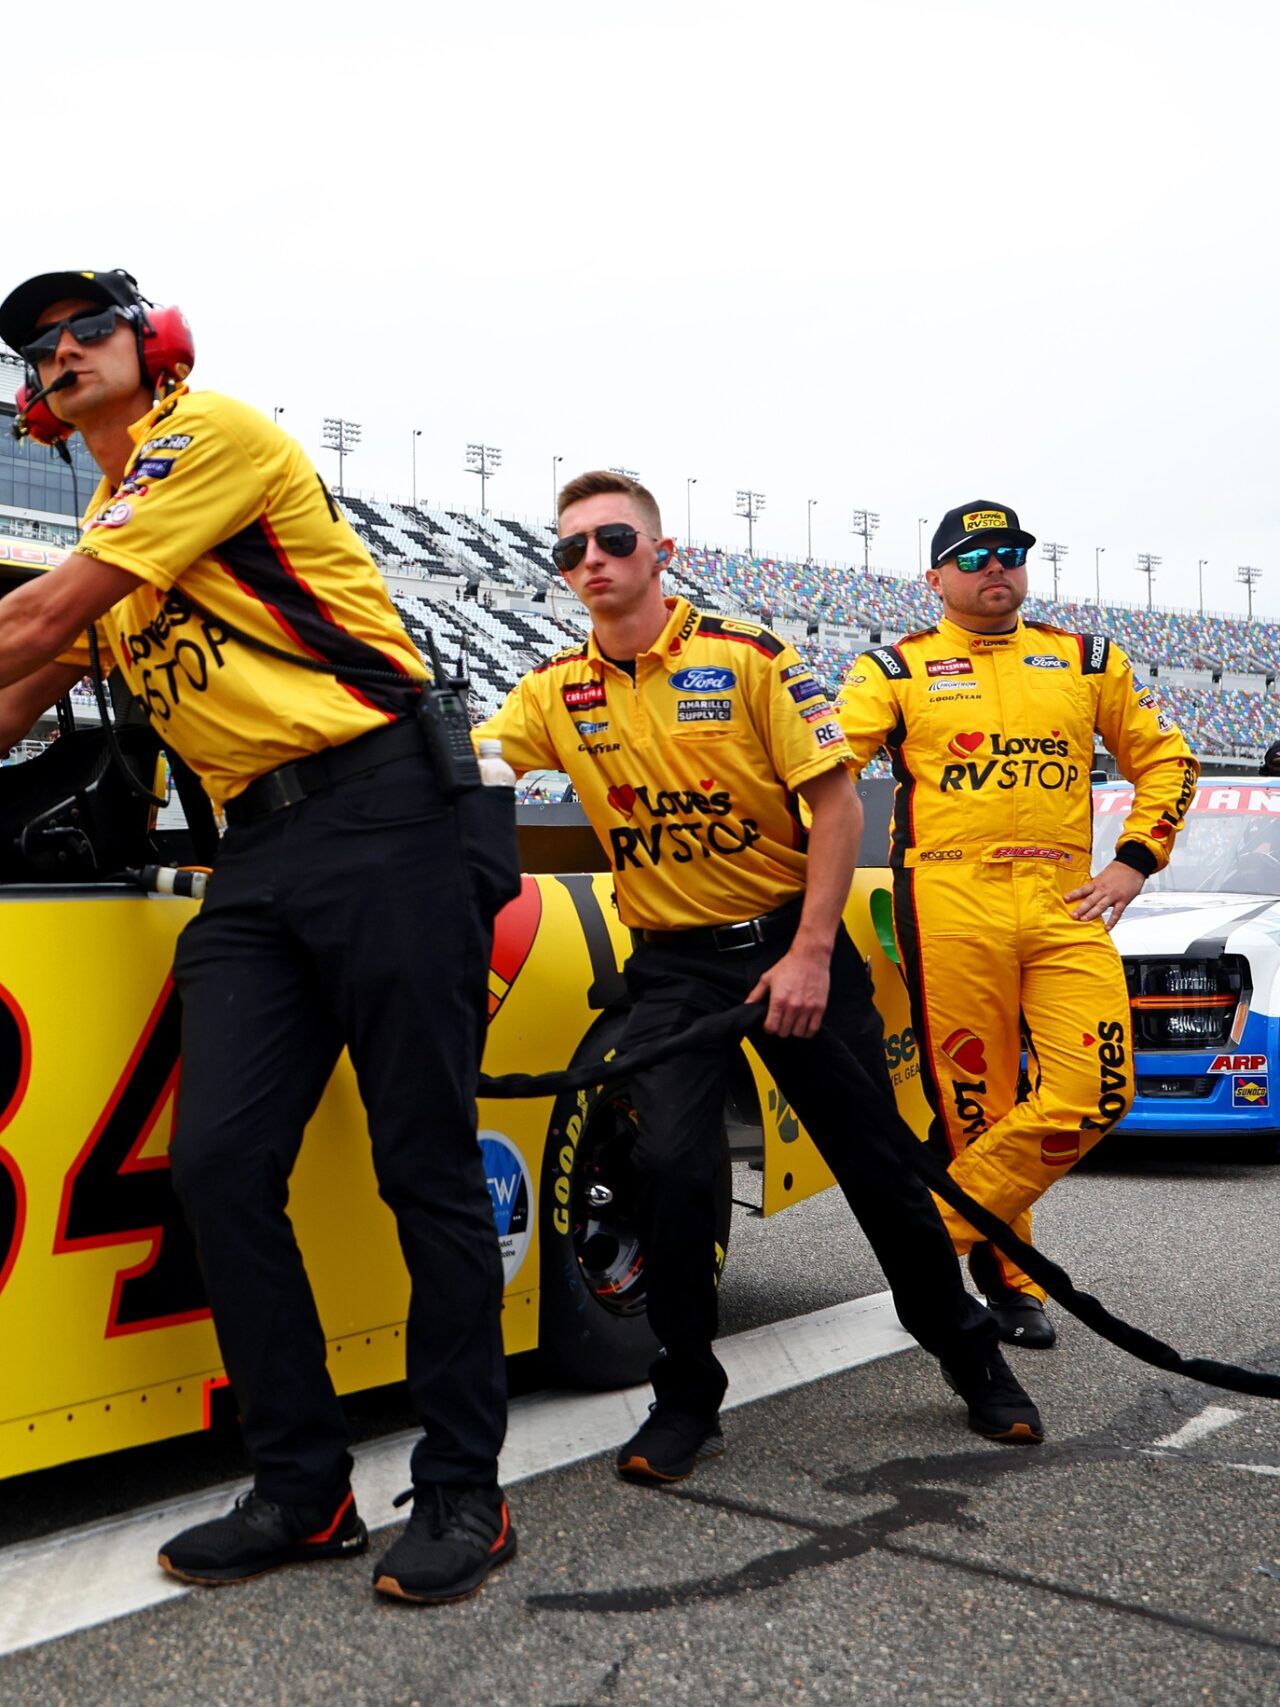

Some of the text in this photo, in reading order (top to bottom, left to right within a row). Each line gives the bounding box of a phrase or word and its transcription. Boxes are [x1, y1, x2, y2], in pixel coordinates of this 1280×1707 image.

[967, 519, 1007, 530] RV STOP
[1091, 636, 1105, 669] sparco
[1031, 655, 1061, 667] Ford
[682, 670, 728, 688] Ford
[678, 700, 730, 709] AMARILLO
[929, 693, 982, 703] GOODYEAR
[678, 711, 715, 720] SUPPLY
[940, 759, 1079, 792] RV STOP
[609, 818, 761, 872] RV STOP
[920, 849, 963, 861] sparco
[992, 846, 1065, 860] RIGGS
[884, 1026, 917, 1070] se
[1210, 1055, 1267, 1070] ARP
[1236, 1088, 1266, 1096] SUNOCO
